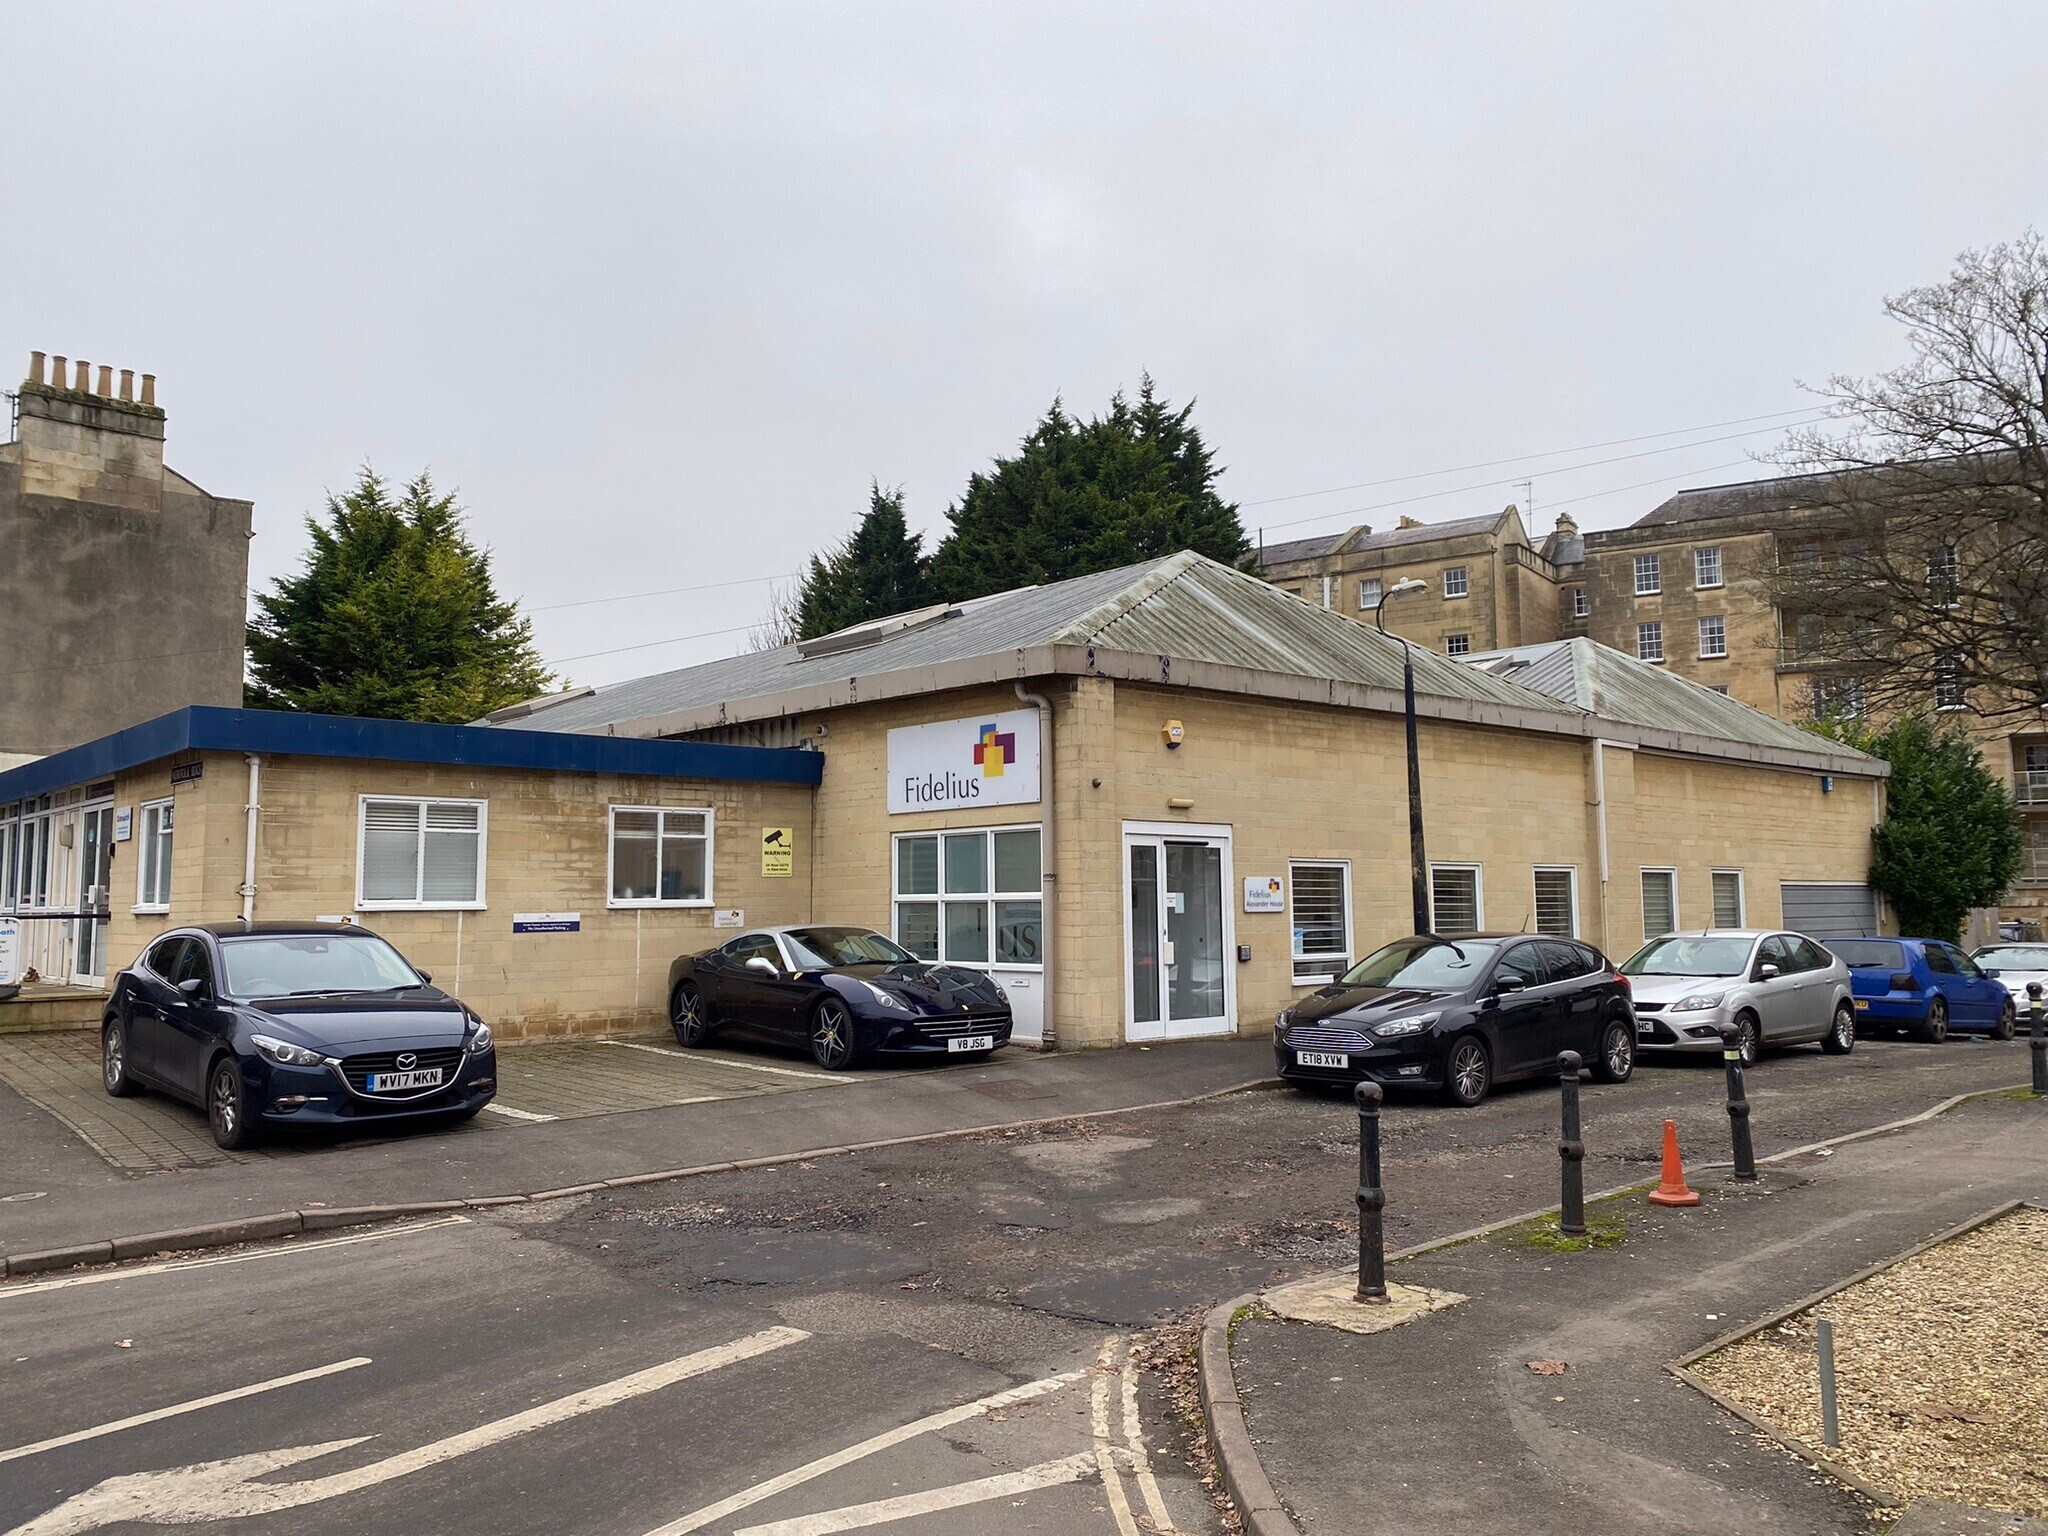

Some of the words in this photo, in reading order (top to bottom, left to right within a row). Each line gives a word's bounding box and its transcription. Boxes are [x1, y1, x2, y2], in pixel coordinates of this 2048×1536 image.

[905, 771, 980, 803] Fidelius
[1249, 890, 1271, 898] Fidelius
[957, 1039, 968, 1050] V8
[970, 1037, 985, 1049] JSG
[1302, 1052, 1322, 1065] ET18
[1324, 1054, 1342, 1066] XVW
[380, 1073, 410, 1088] WV17
[413, 1070, 438, 1085] MKN
